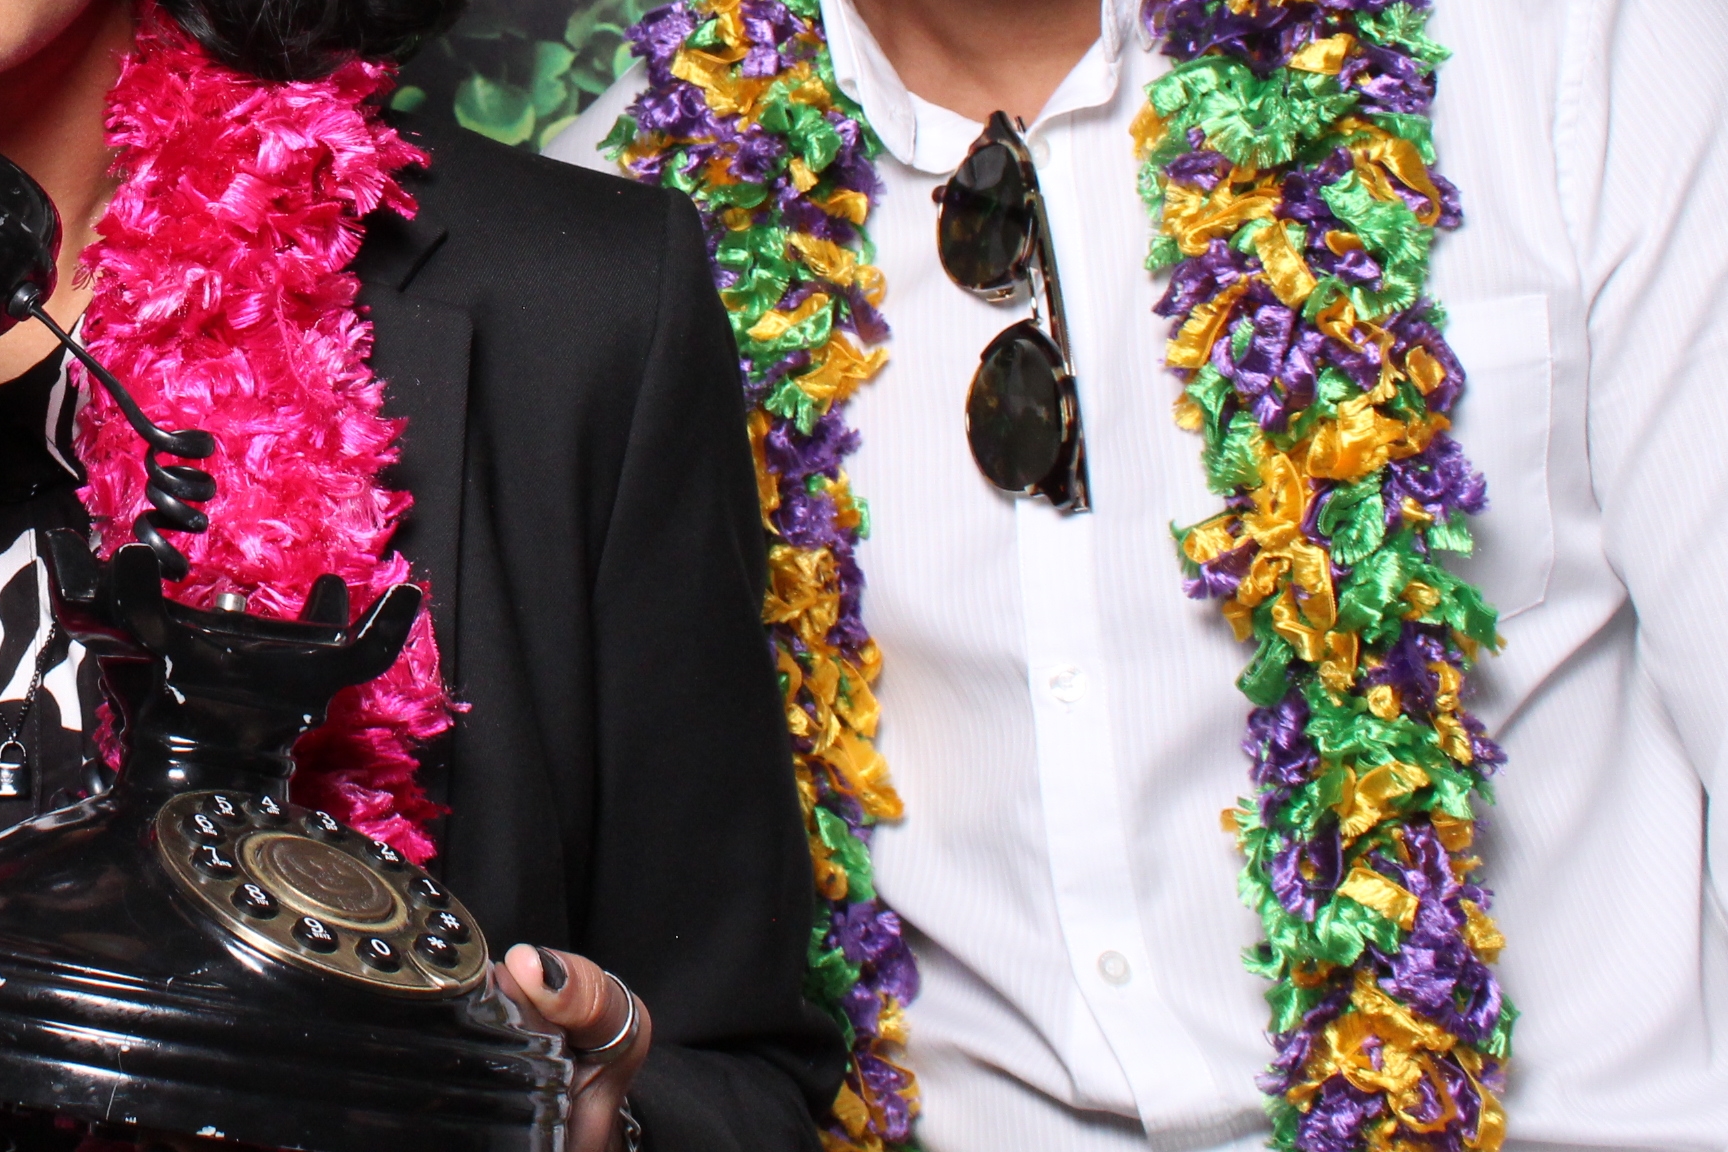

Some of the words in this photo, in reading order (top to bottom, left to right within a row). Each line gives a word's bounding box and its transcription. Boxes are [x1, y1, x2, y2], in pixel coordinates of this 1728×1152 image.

[214, 795, 233, 811] 5
[261, 795, 278, 810] 4
[194, 813, 214, 830] 6
[315, 810, 337, 826] 3
[202, 845, 221, 861] 7
[373, 840, 395, 856] 2
[244, 883, 266, 900] 8
[422, 879, 441, 896] 1
[303, 916, 325, 933] 9
